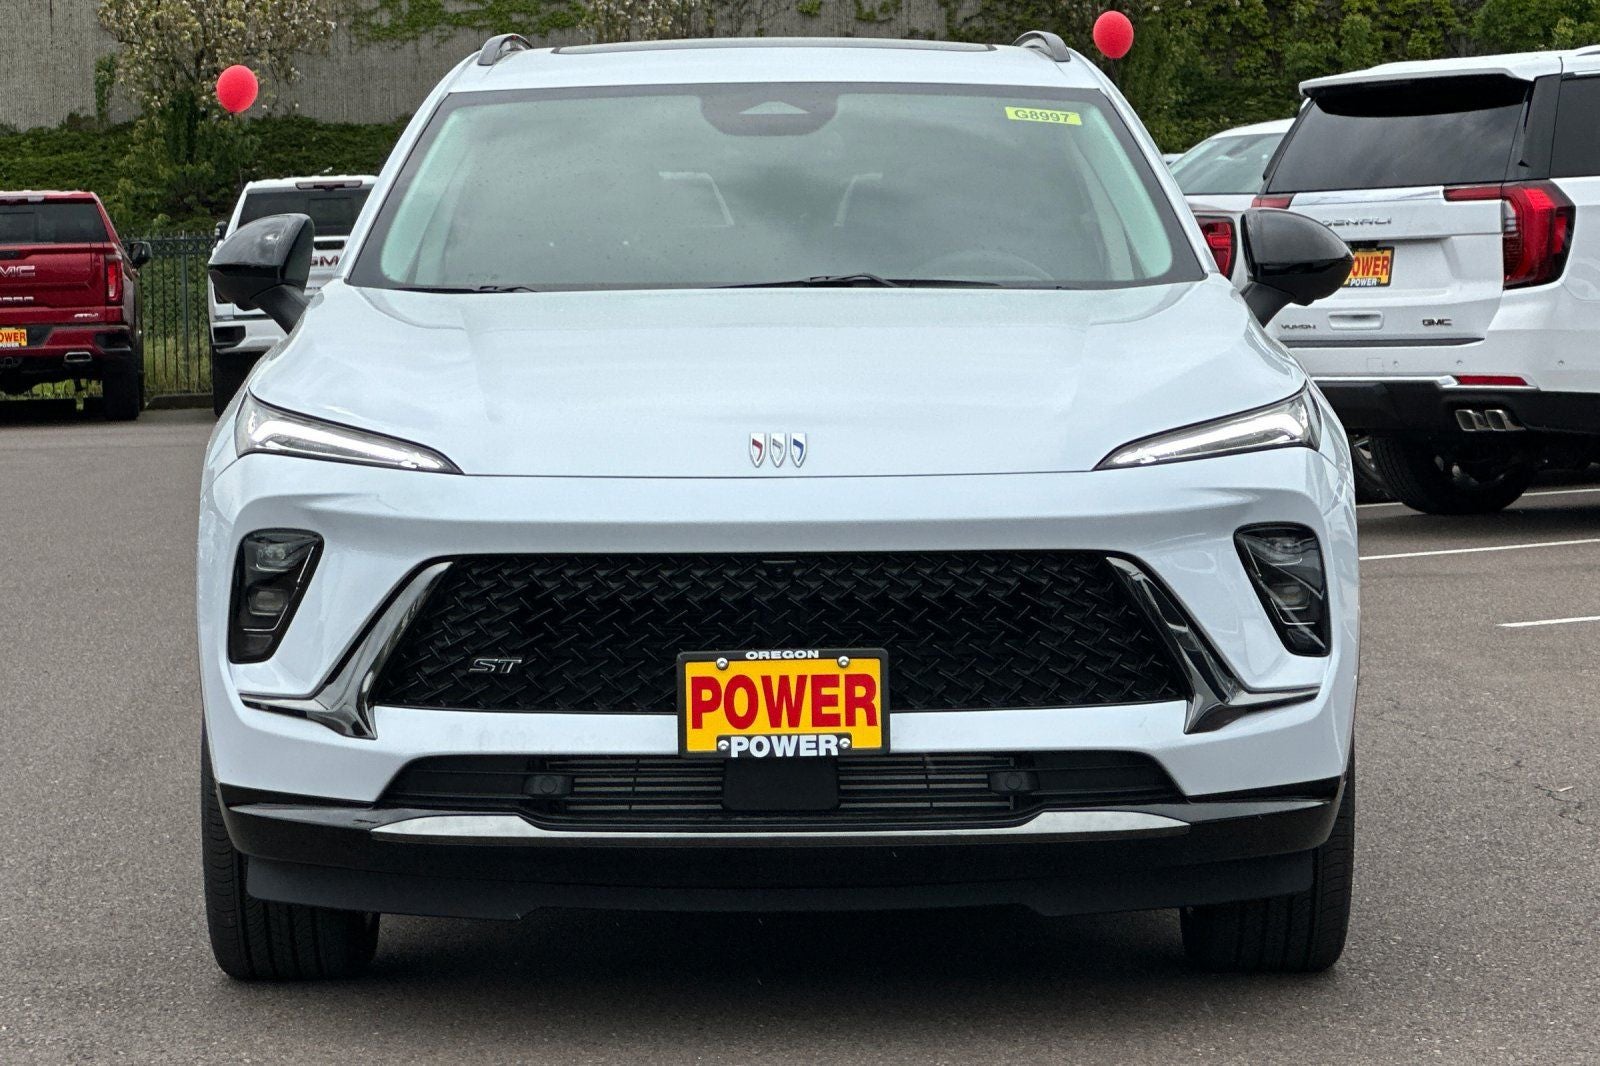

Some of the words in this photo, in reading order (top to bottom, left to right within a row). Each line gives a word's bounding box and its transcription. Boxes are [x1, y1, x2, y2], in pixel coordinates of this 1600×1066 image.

[1014, 109, 1070, 122] G8997
[0, 265, 36, 277] MC
[1352, 256, 1390, 276] OWER
[1350, 278, 1377, 286] POWER
[1422, 318, 1452, 326] GMC
[0, 332, 26, 342] OWER
[745, 650, 820, 660] OREGON
[468, 658, 522, 674] ST
[690, 674, 878, 730] POWER
[730, 734, 839, 758] POWER
